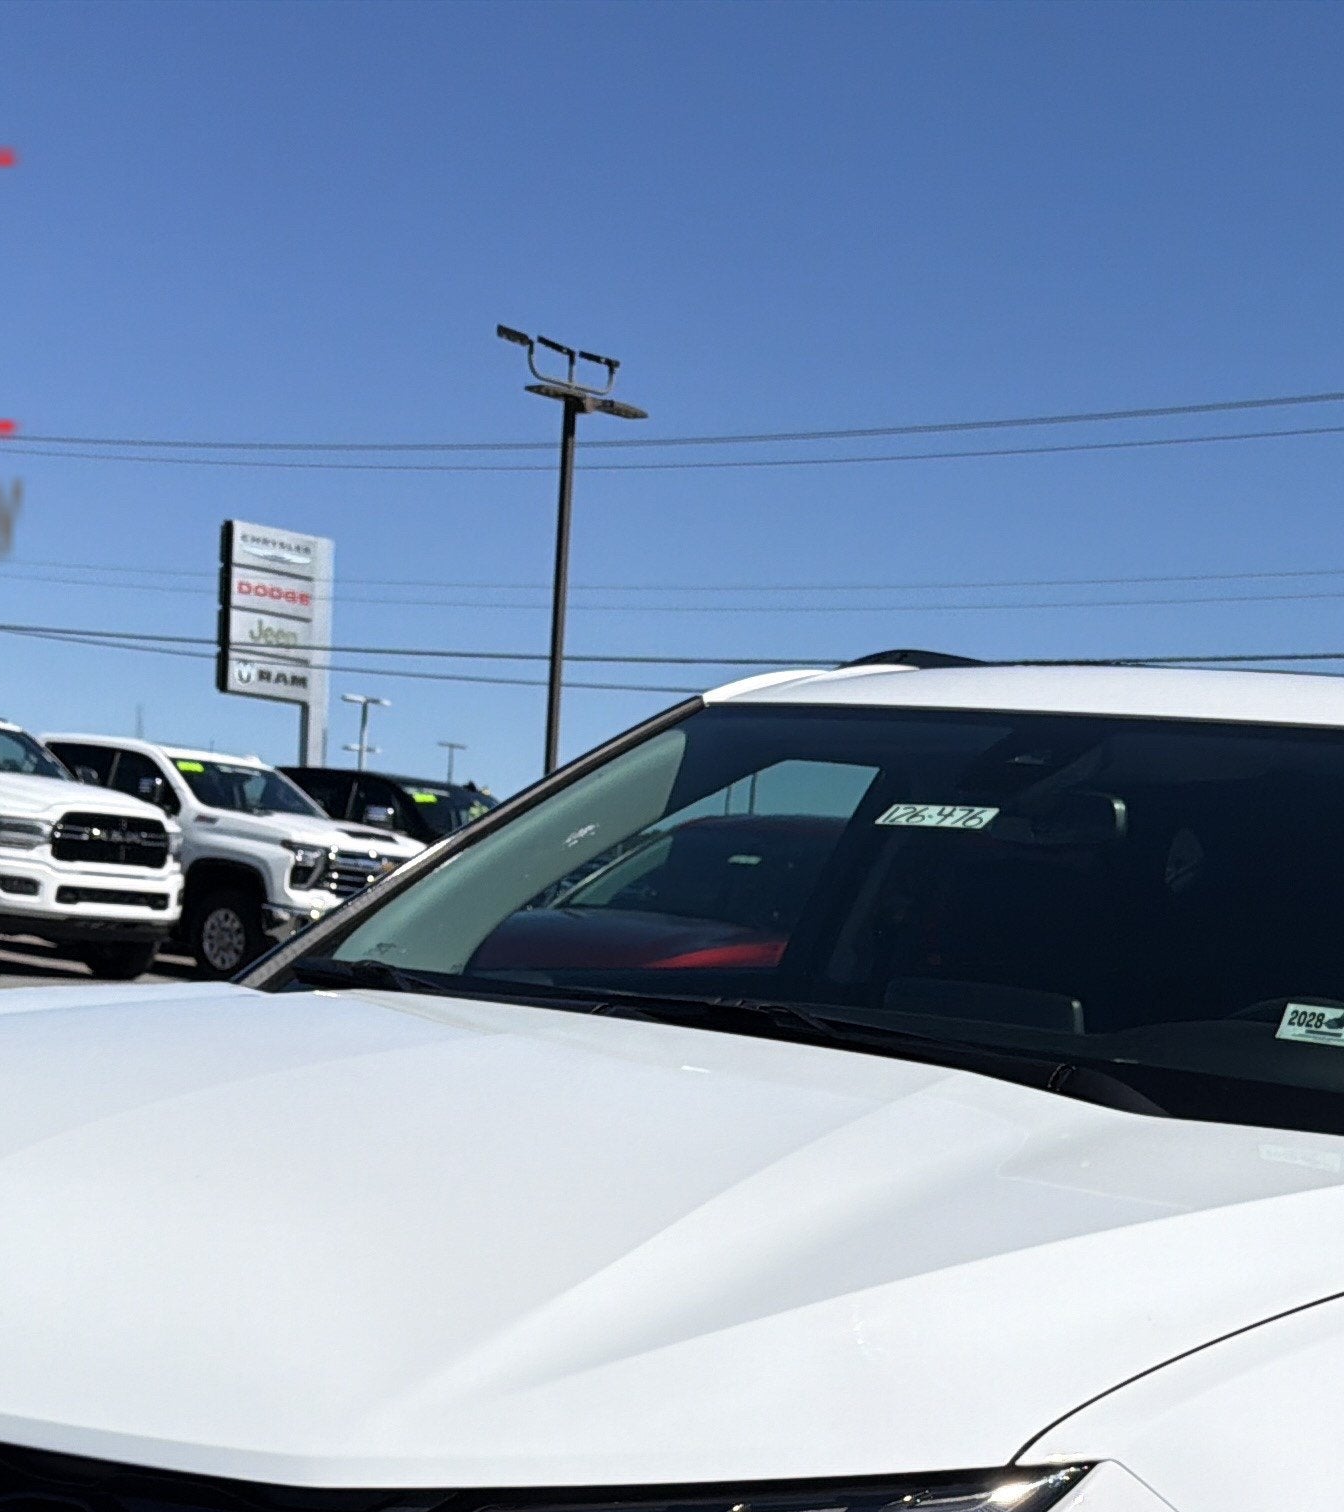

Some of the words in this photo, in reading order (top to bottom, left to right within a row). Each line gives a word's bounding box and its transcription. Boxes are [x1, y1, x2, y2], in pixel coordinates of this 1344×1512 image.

[236, 580, 313, 607] DODGE
[249, 618, 298, 646] Jeep
[258, 668, 309, 690] RAM
[1287, 1009, 1325, 1029] 2028
